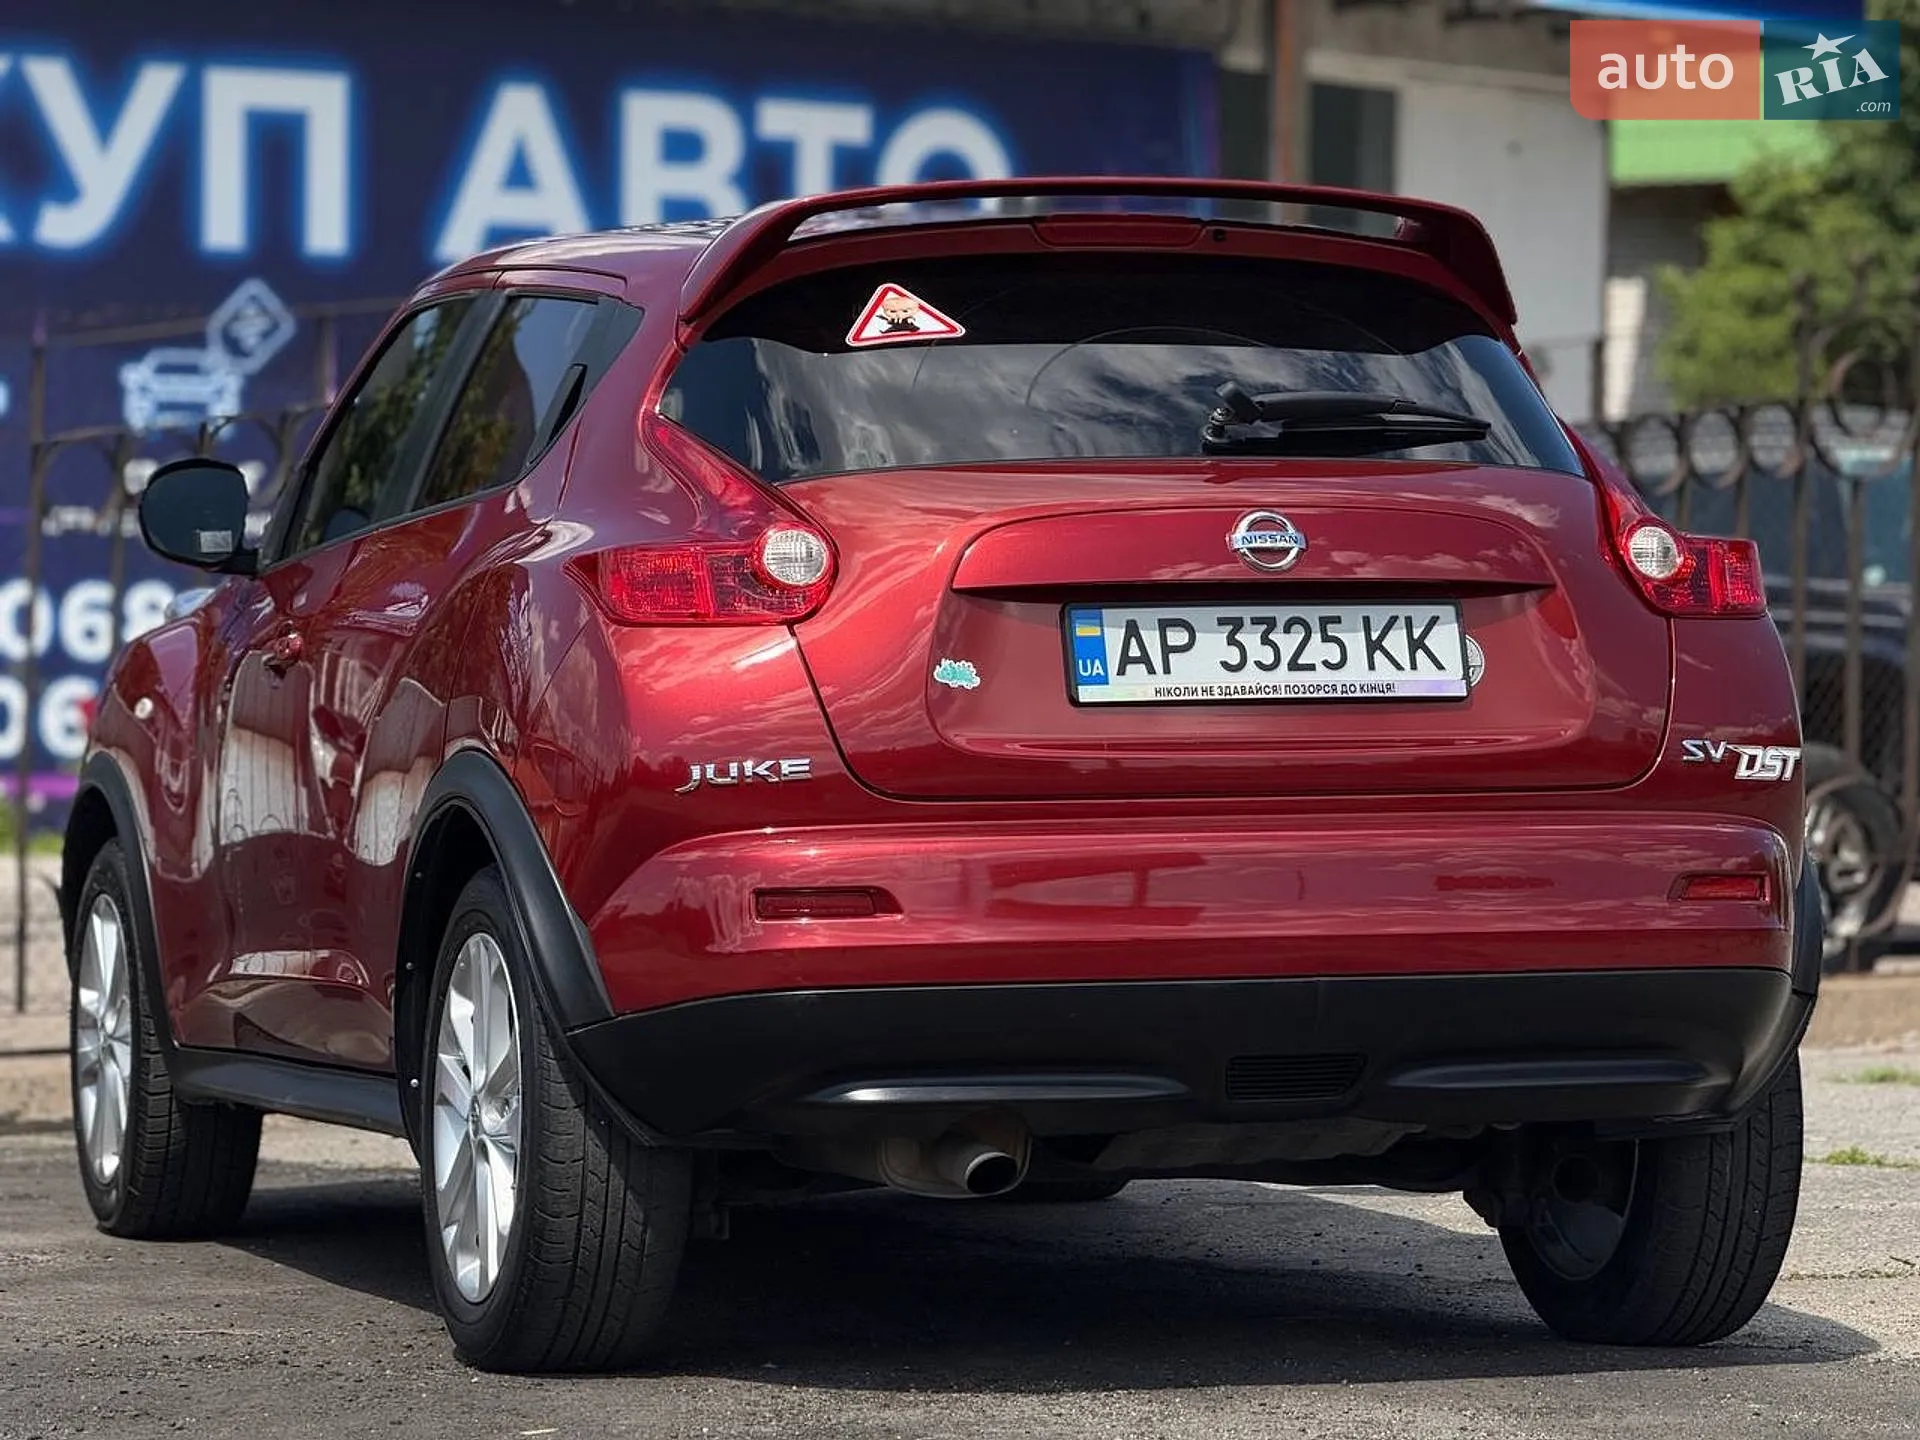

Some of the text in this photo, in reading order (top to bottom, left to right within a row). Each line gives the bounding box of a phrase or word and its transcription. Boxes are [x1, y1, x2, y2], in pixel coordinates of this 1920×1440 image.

[0, 56, 350, 256] УП
[1241, 534, 1299, 545] NISSAN
[1116, 614, 1446, 676] AP 3325 KK
[1078, 659, 1105, 677] UA
[1154, 682, 1396, 698] НІКОЛИ НЕ ЗДАВАЙСЯ! ПОЗОРСЯ ДО КІНЦЯ!
[1681, 739, 1728, 762] SV
[674, 758, 812, 794] JUKE
